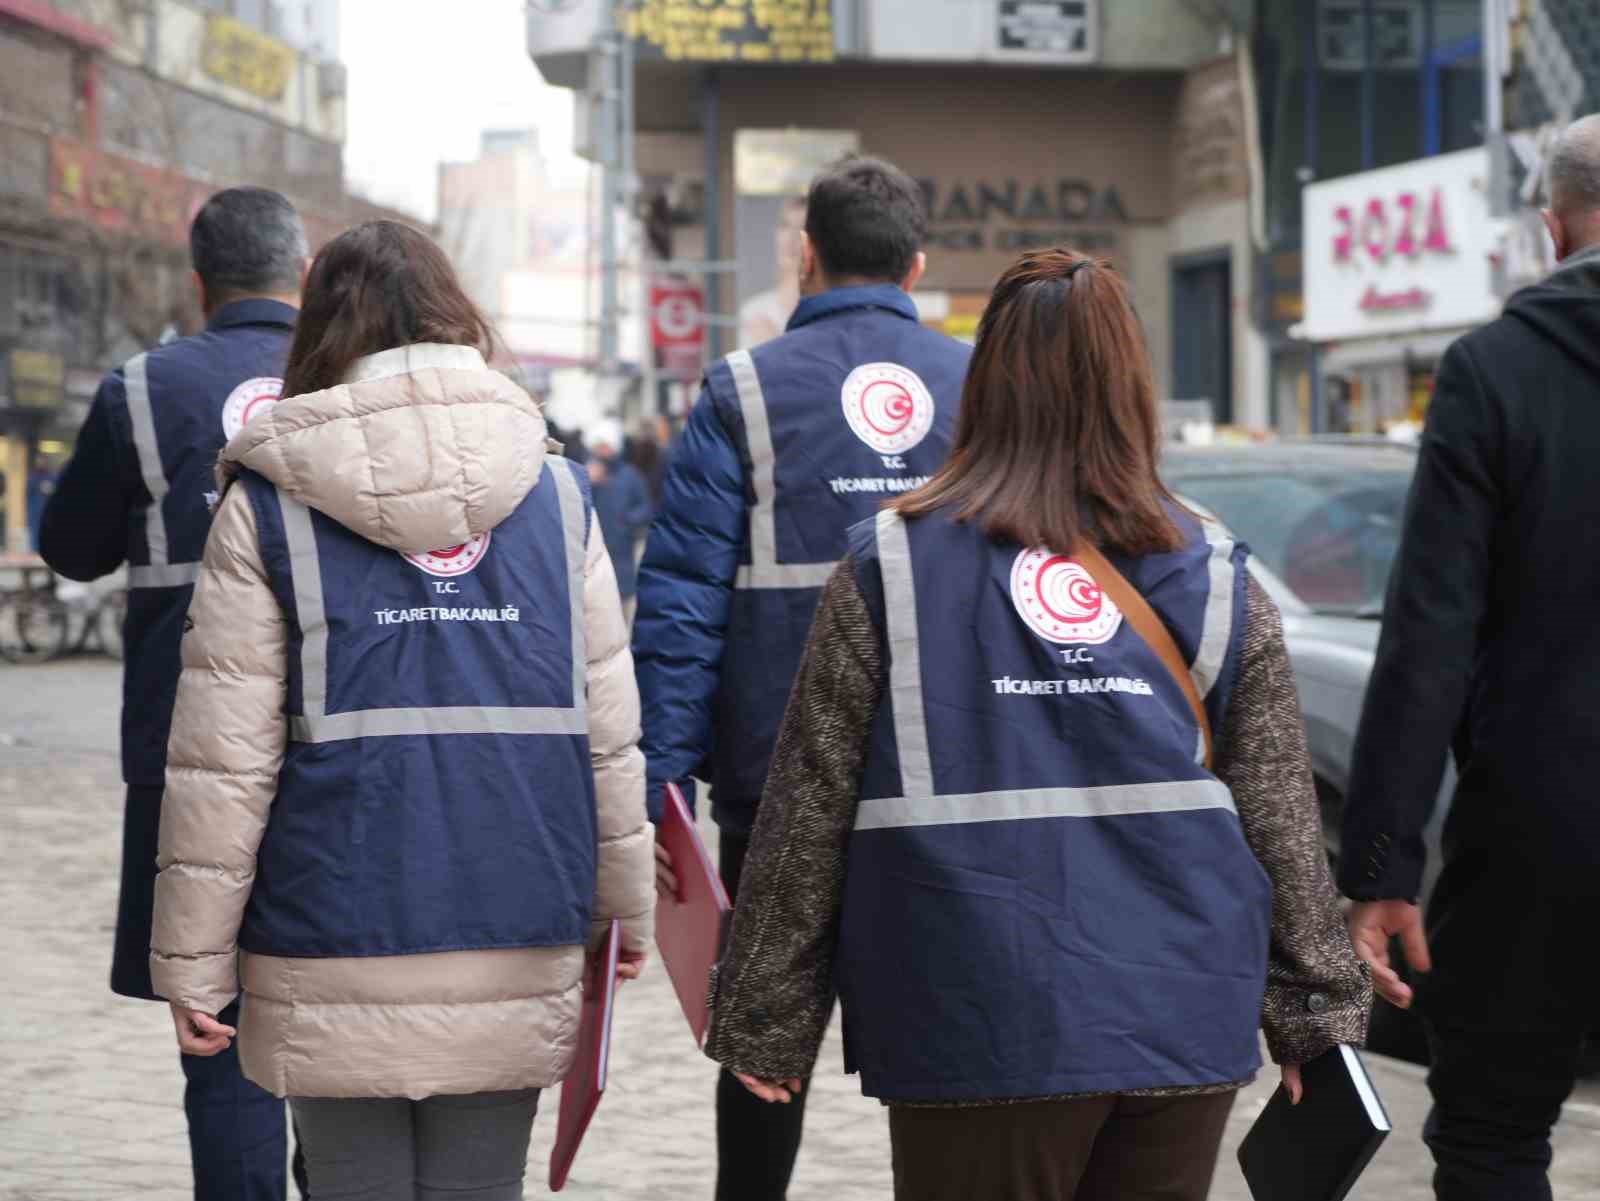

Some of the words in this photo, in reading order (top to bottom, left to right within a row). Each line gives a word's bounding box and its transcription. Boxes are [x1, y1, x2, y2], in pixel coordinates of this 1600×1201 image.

[880, 455, 907, 469] T.C.
[828, 476, 886, 494] TİCARET
[432, 581, 460, 594] T.C.
[1059, 647, 1094, 664] T.C.
[991, 675, 1065, 695] TİCARET
